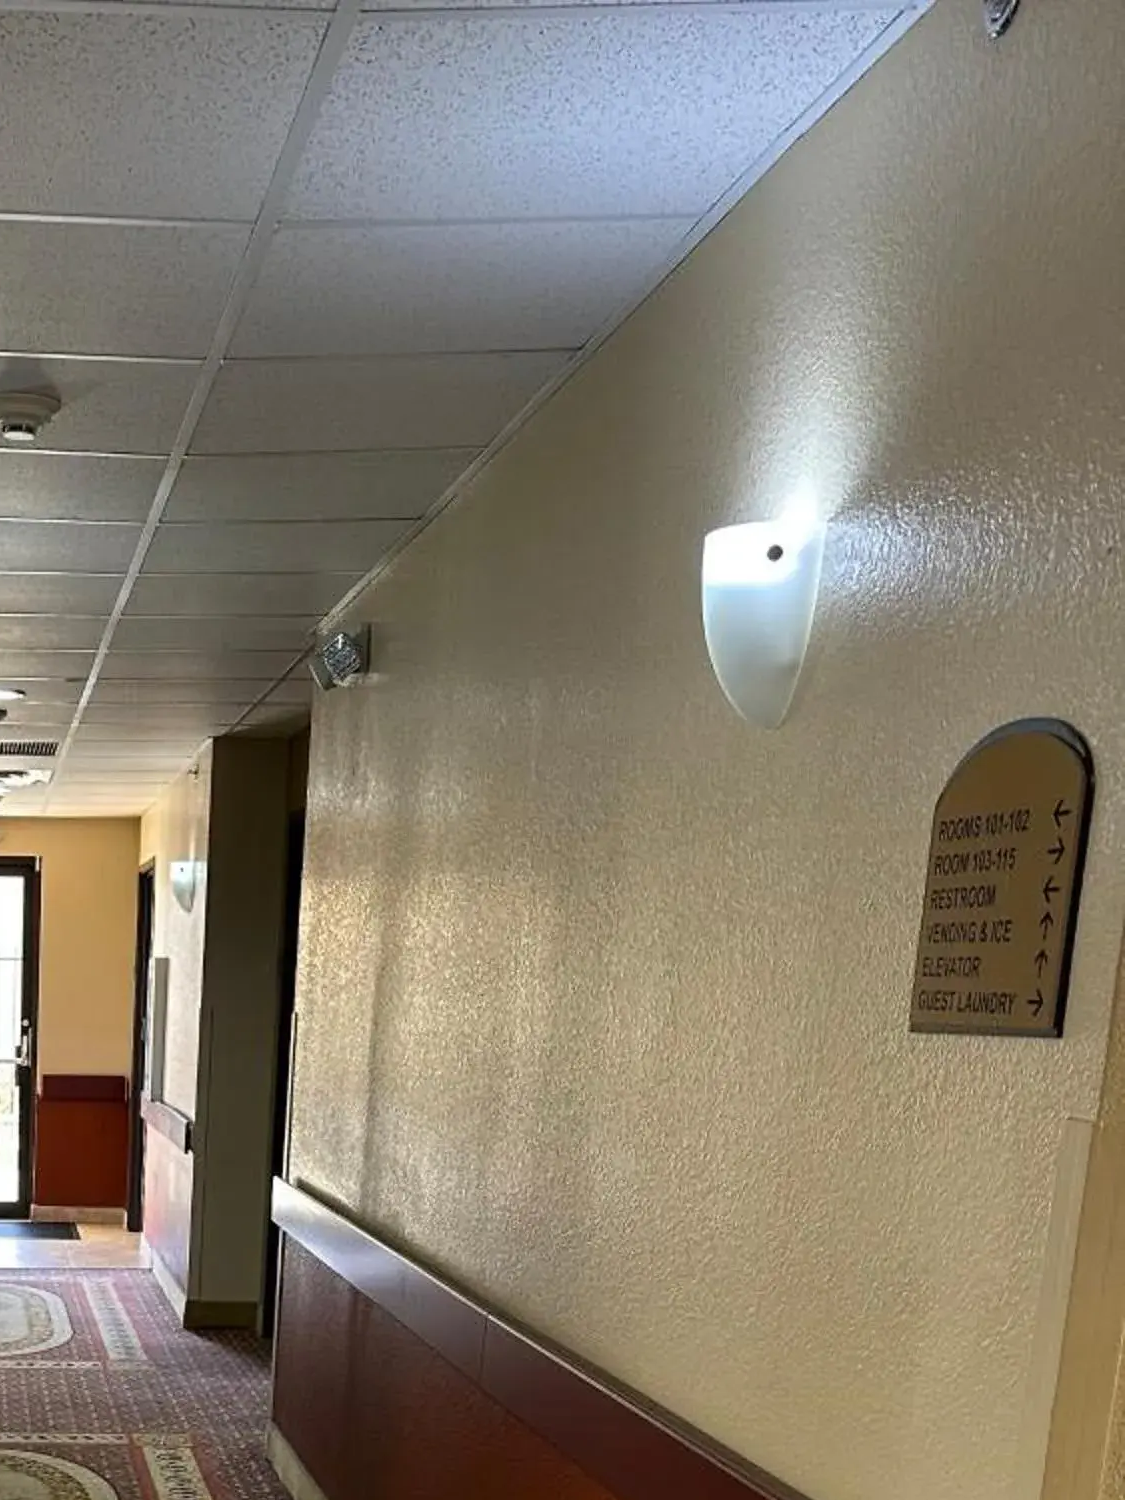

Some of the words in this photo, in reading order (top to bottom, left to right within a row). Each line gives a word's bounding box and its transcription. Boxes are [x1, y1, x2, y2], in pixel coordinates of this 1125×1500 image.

[939, 815, 982, 841] ROOMS
[985, 809, 1030, 836] 101-102
[934, 852, 970, 876] ROOM
[930, 884, 997, 910] RESTROOM
[927, 921, 977, 944] VENDING
[979, 919, 989, 943] &
[990, 919, 1013, 943] ICE
[922, 956, 982, 978] ELEVATOR
[918, 990, 956, 1012] GUEST
[957, 991, 1018, 1015] LAUNDRY
